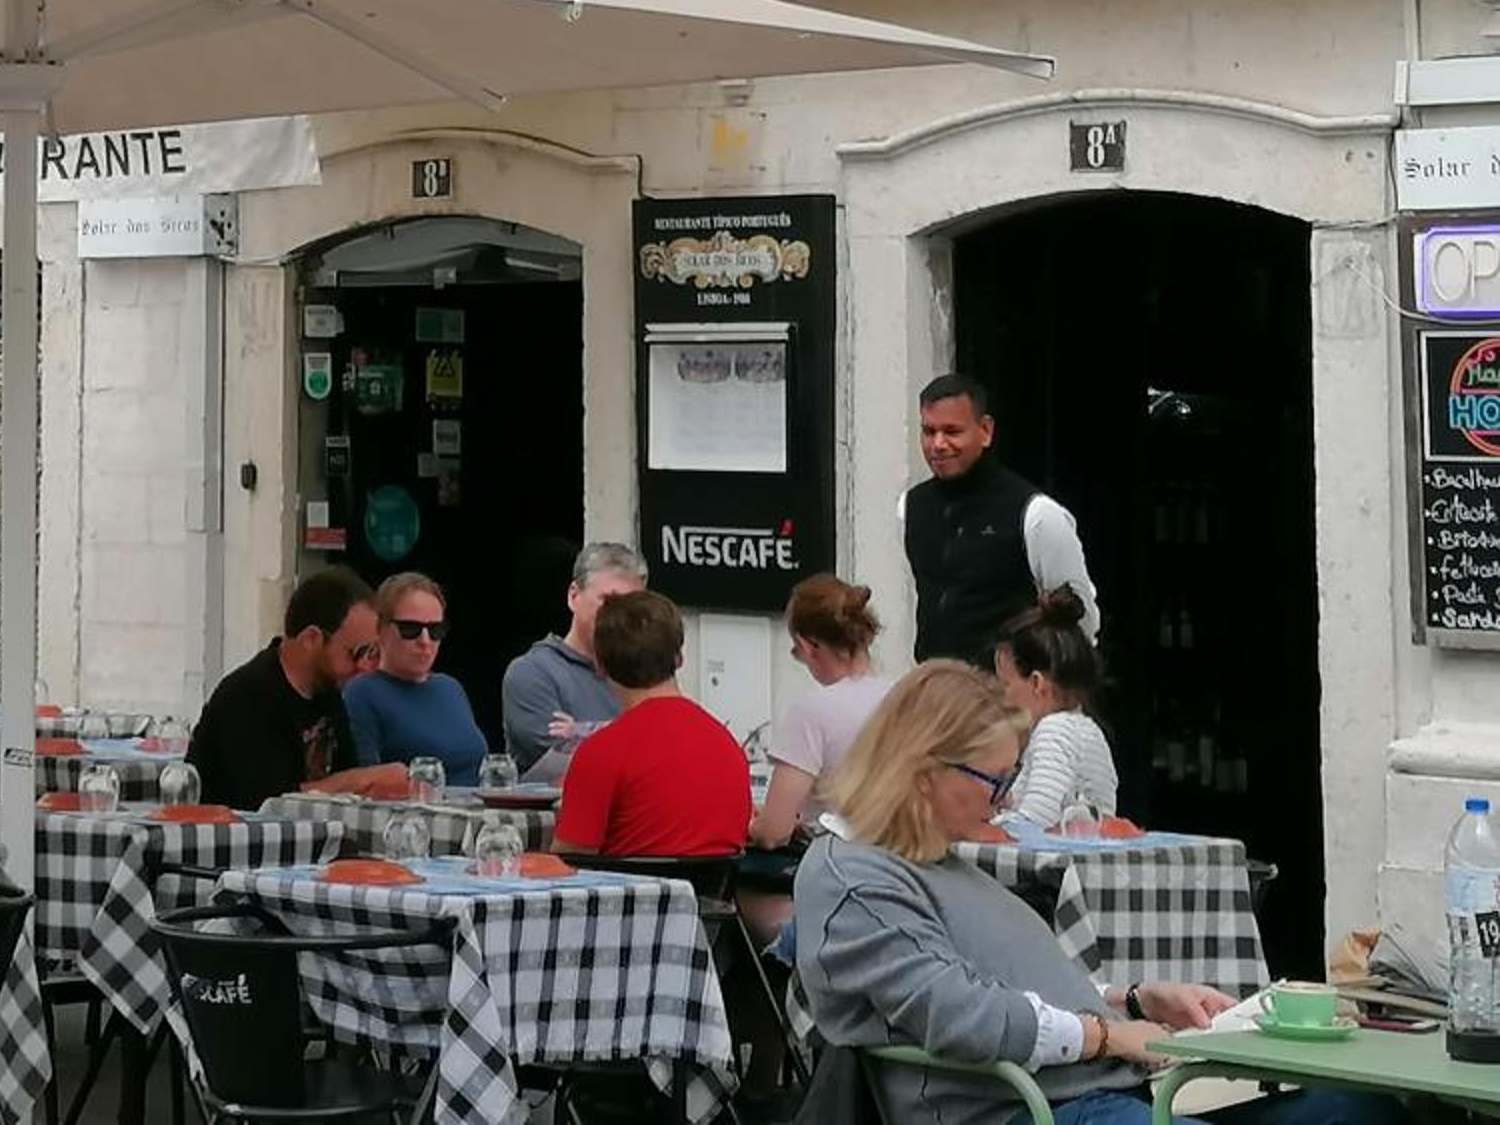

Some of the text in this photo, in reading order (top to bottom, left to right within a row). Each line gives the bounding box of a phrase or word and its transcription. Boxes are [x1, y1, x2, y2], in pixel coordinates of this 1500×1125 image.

[1087, 125, 1116, 167] 8A
[1403, 158, 1472, 178] Solar
[661, 520, 799, 569] NESCAFÉ
